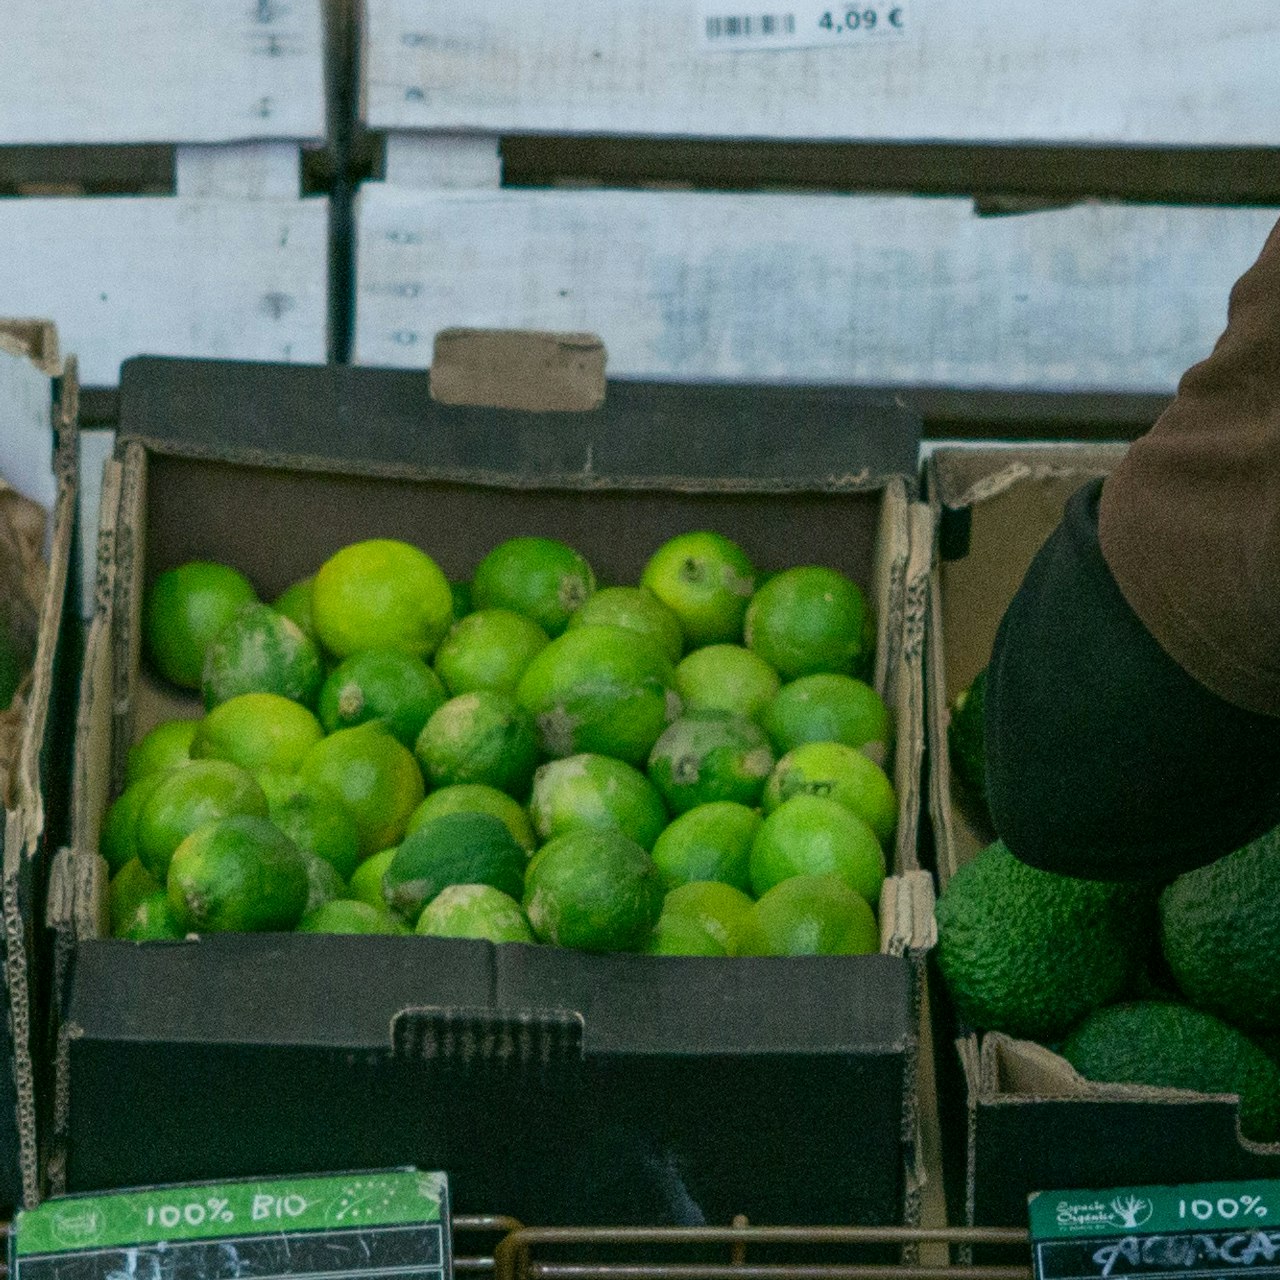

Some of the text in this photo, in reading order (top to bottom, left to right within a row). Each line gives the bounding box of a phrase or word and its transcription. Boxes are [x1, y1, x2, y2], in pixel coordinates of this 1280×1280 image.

[819, 7, 904, 33] 4,09 €
[147, 1193, 307, 1227] 100% BIO
[1179, 1194, 1267, 1222] 100%
